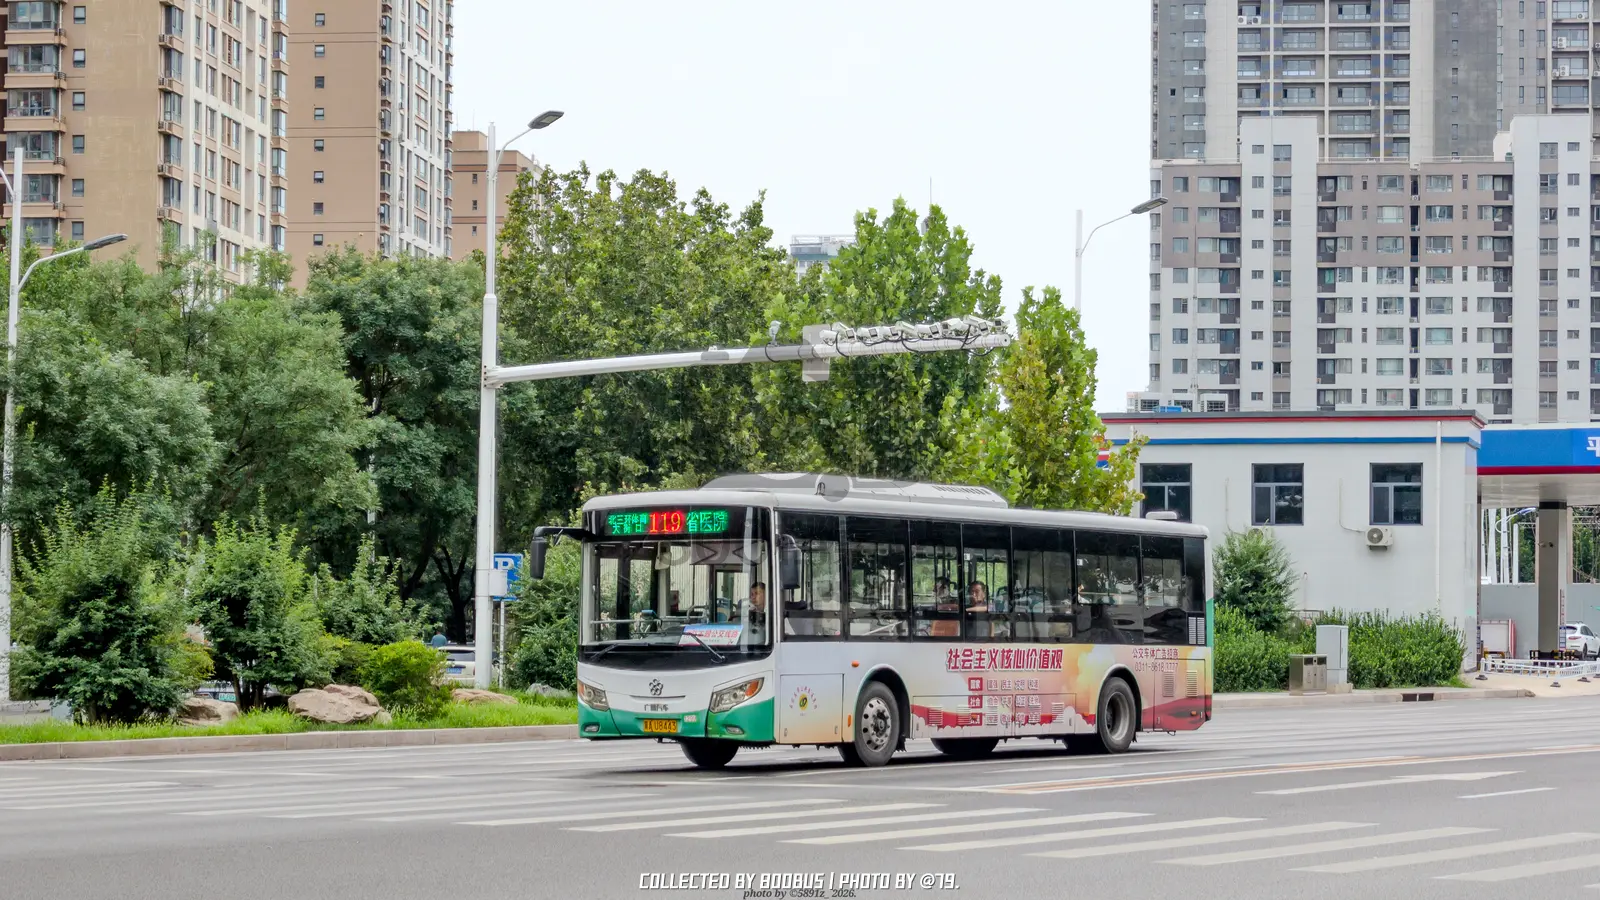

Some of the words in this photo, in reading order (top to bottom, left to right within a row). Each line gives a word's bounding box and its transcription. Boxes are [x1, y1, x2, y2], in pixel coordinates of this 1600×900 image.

[649, 512, 681, 533] 119
[686, 511, 726, 532] 省医院
[947, 648, 1064, 670] 社会主义核心价值观
